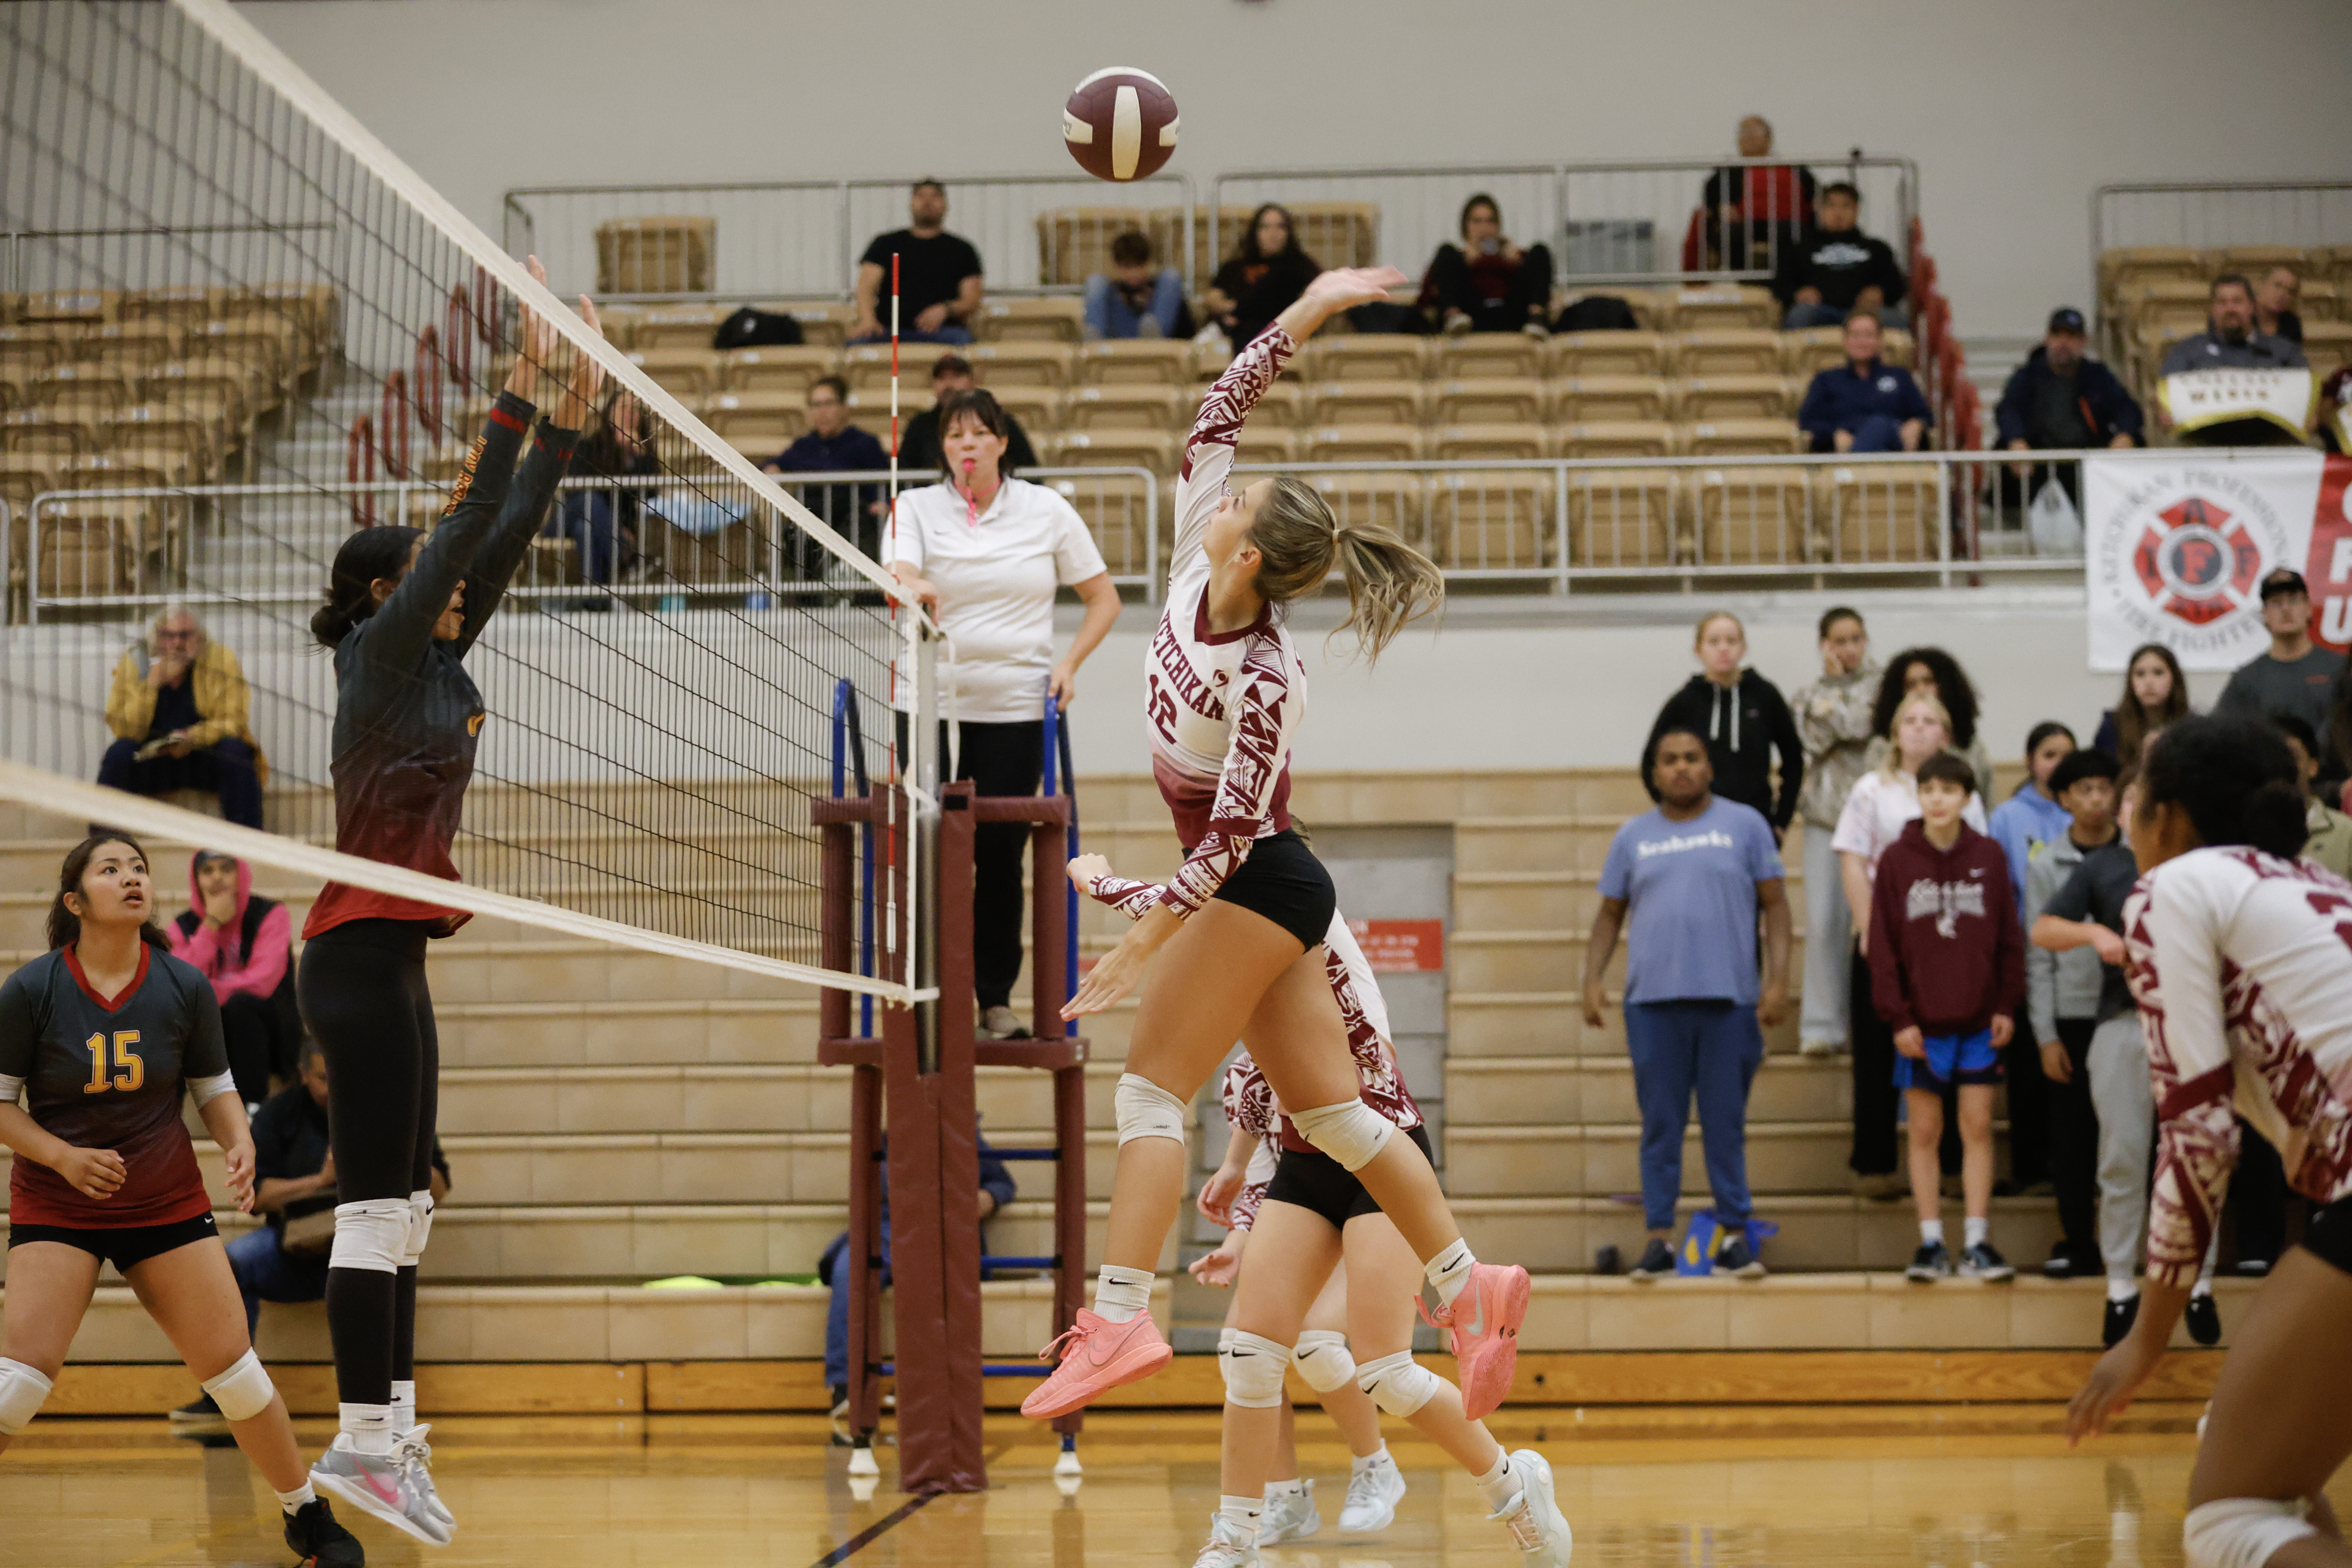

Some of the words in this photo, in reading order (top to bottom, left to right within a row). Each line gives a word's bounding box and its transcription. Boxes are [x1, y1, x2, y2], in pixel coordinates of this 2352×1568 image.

[1147, 674, 1177, 745] 12
[1637, 829, 1733, 860] Seahawks
[84, 1030, 143, 1094] 15
